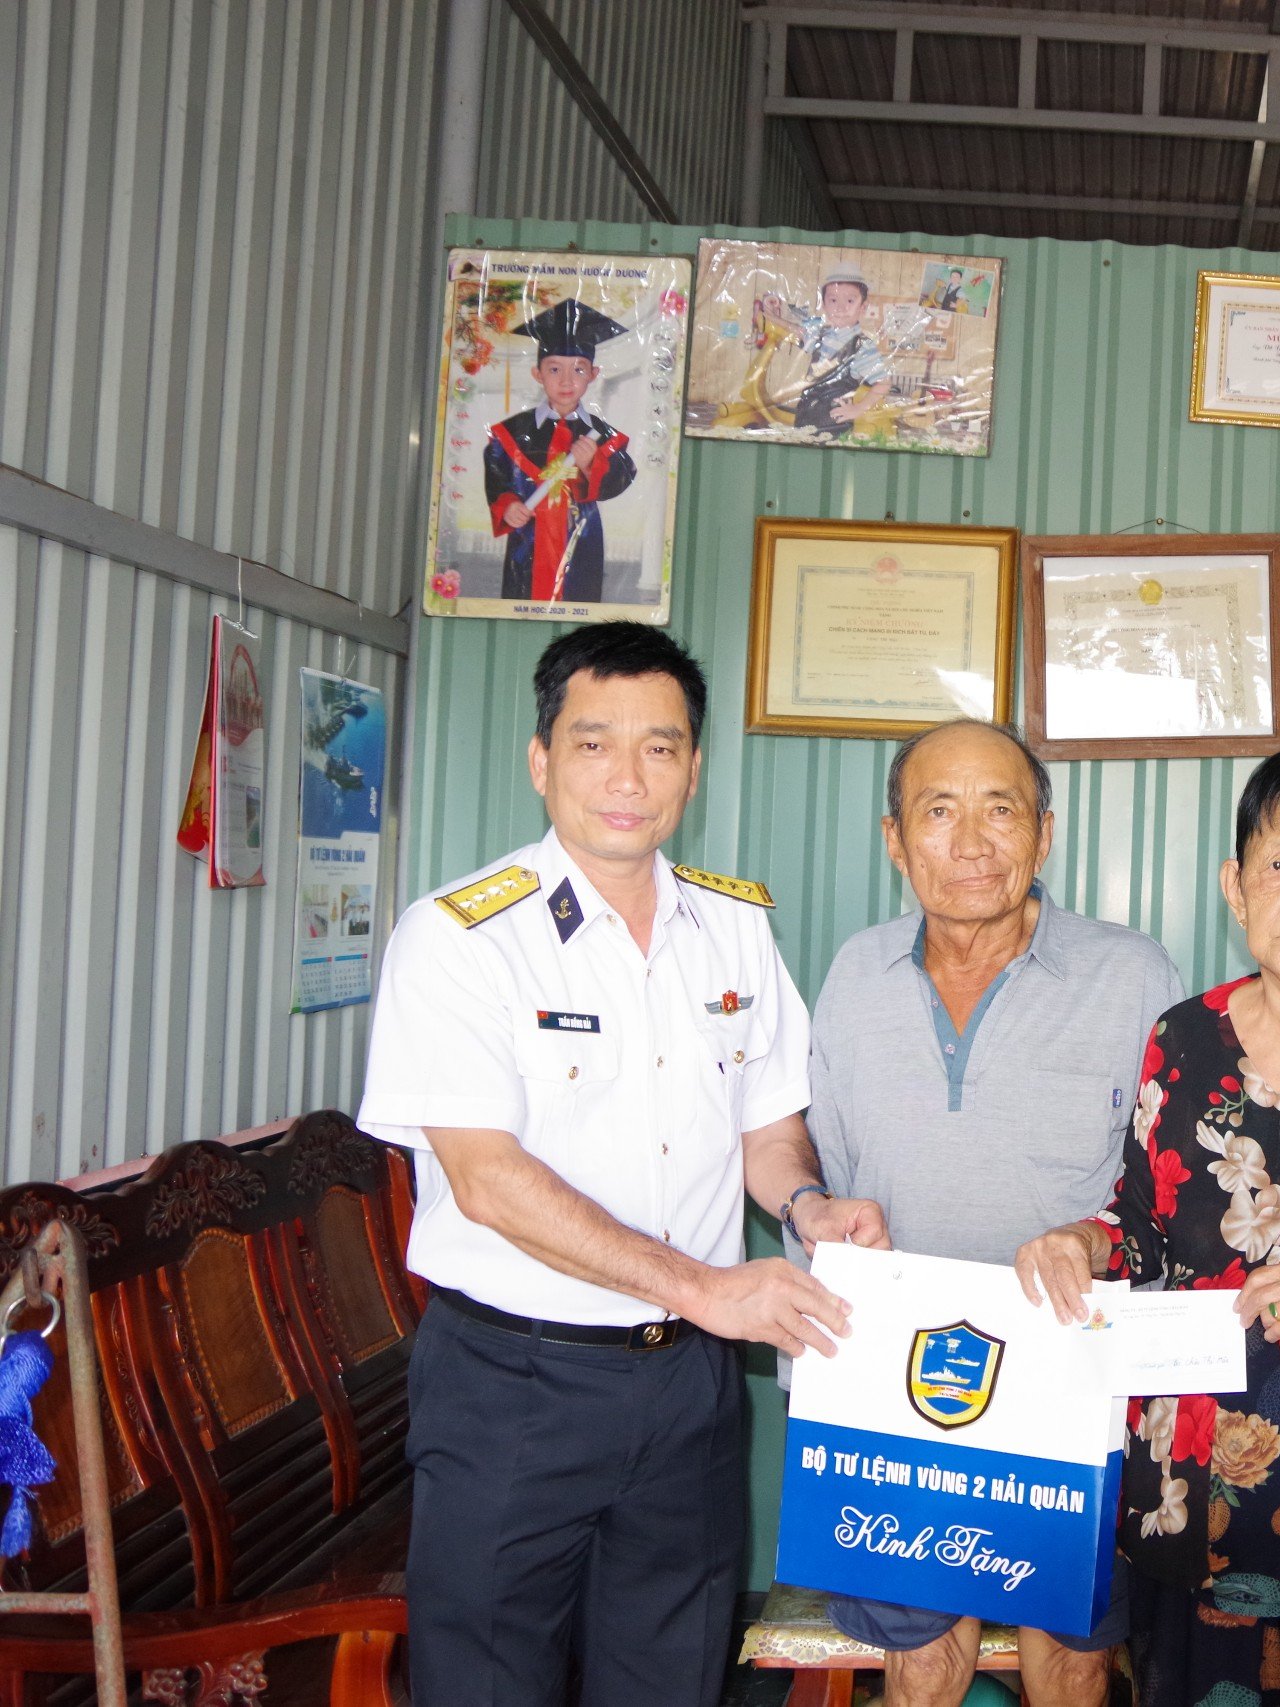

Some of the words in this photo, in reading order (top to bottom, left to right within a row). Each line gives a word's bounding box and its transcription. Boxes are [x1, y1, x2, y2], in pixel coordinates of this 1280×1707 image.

[558, 267, 577, 275] NON
[572, 608, 589, 616] 2021
[801, 1445, 827, 1476] BỘ
[833, 1452, 860, 1477] TƯ
[861, 1455, 911, 1486] LỆNH
[917, 1463, 968, 1496] VÙNG
[972, 1475, 986, 1499] 2
[990, 1473, 1025, 1505] HẢI
[1029, 1484, 1085, 1514] QUÂN
[934, 1524, 1036, 1592] Tặng
